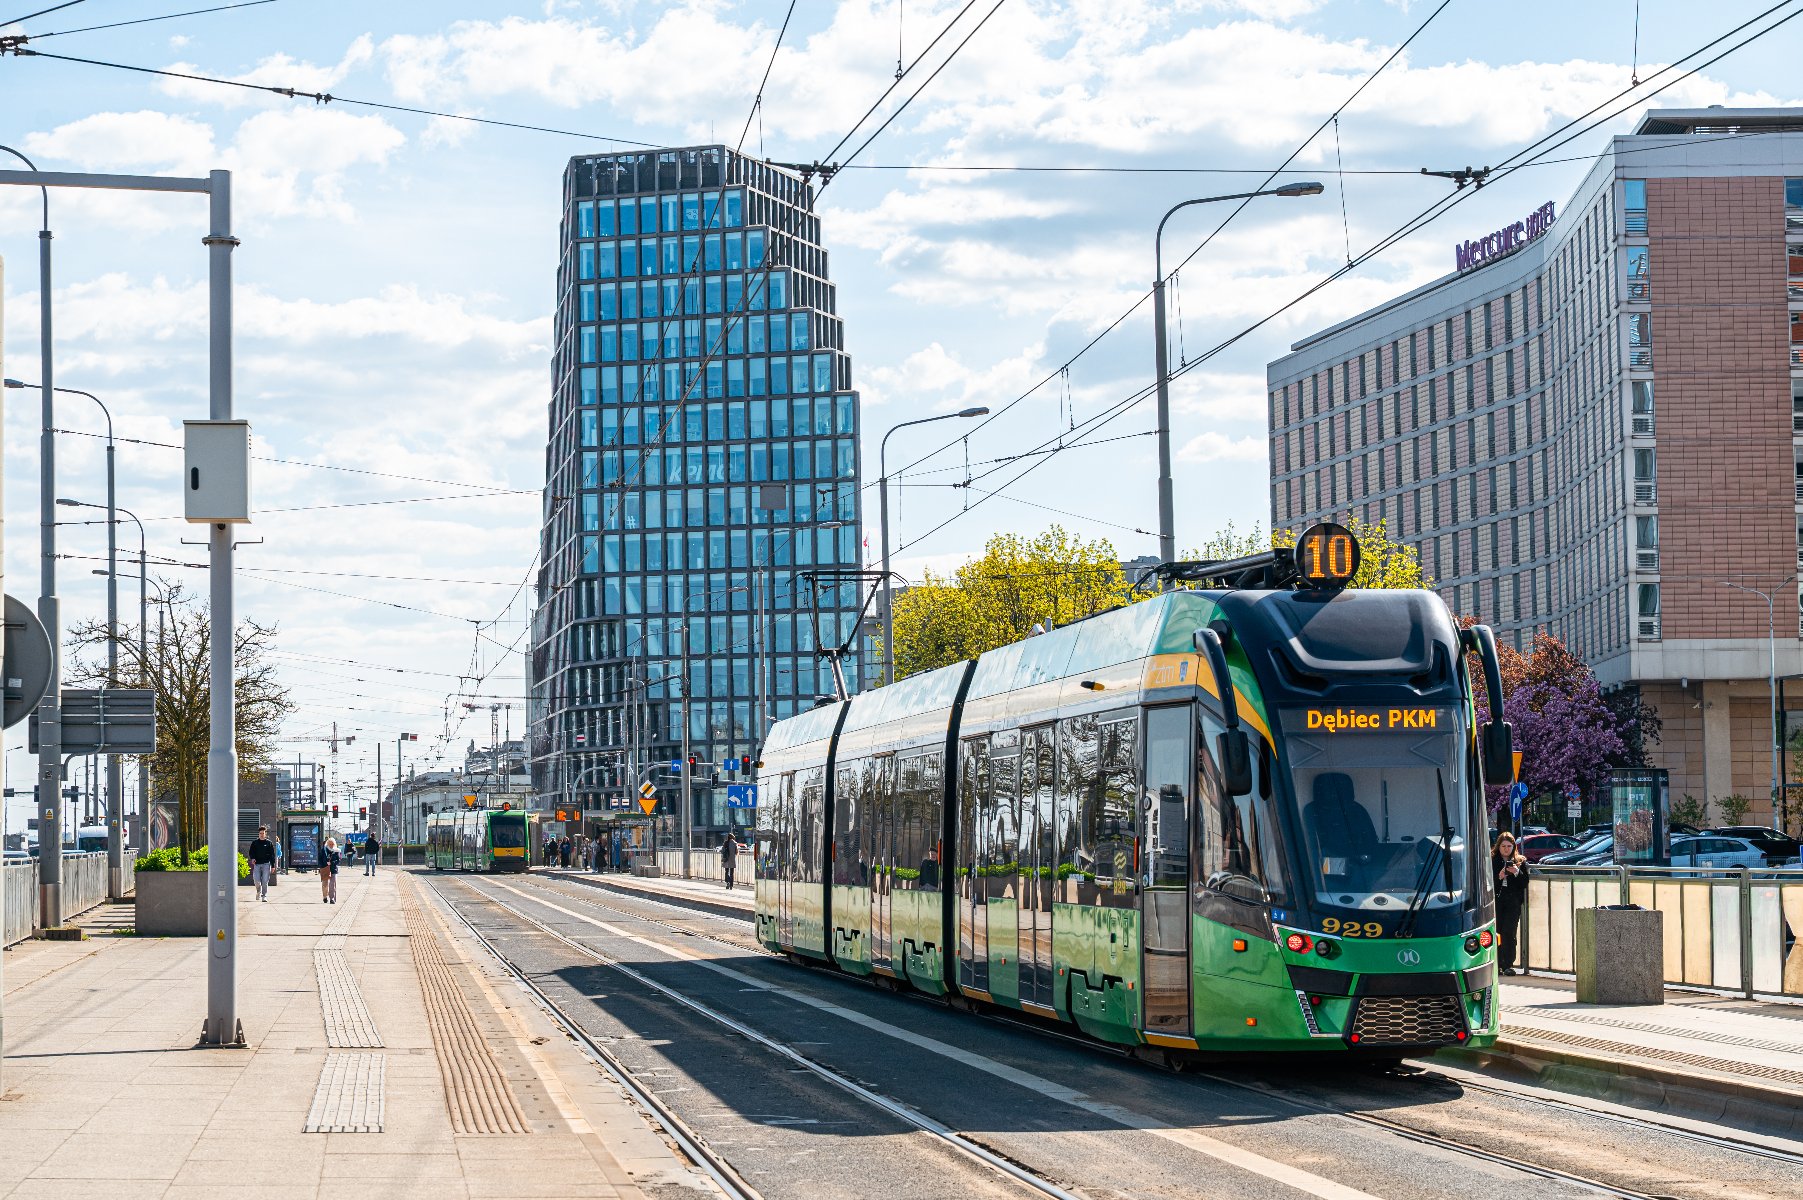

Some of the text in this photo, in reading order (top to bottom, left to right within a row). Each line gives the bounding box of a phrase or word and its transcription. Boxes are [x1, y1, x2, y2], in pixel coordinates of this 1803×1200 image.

[1456, 221, 1524, 271] Mercure
[1308, 534, 1353, 578] 10
[1307, 708, 1436, 733] Dębiec PKM
[1629, 793, 1645, 801] PIT
[1322, 917, 1383, 938] 929
